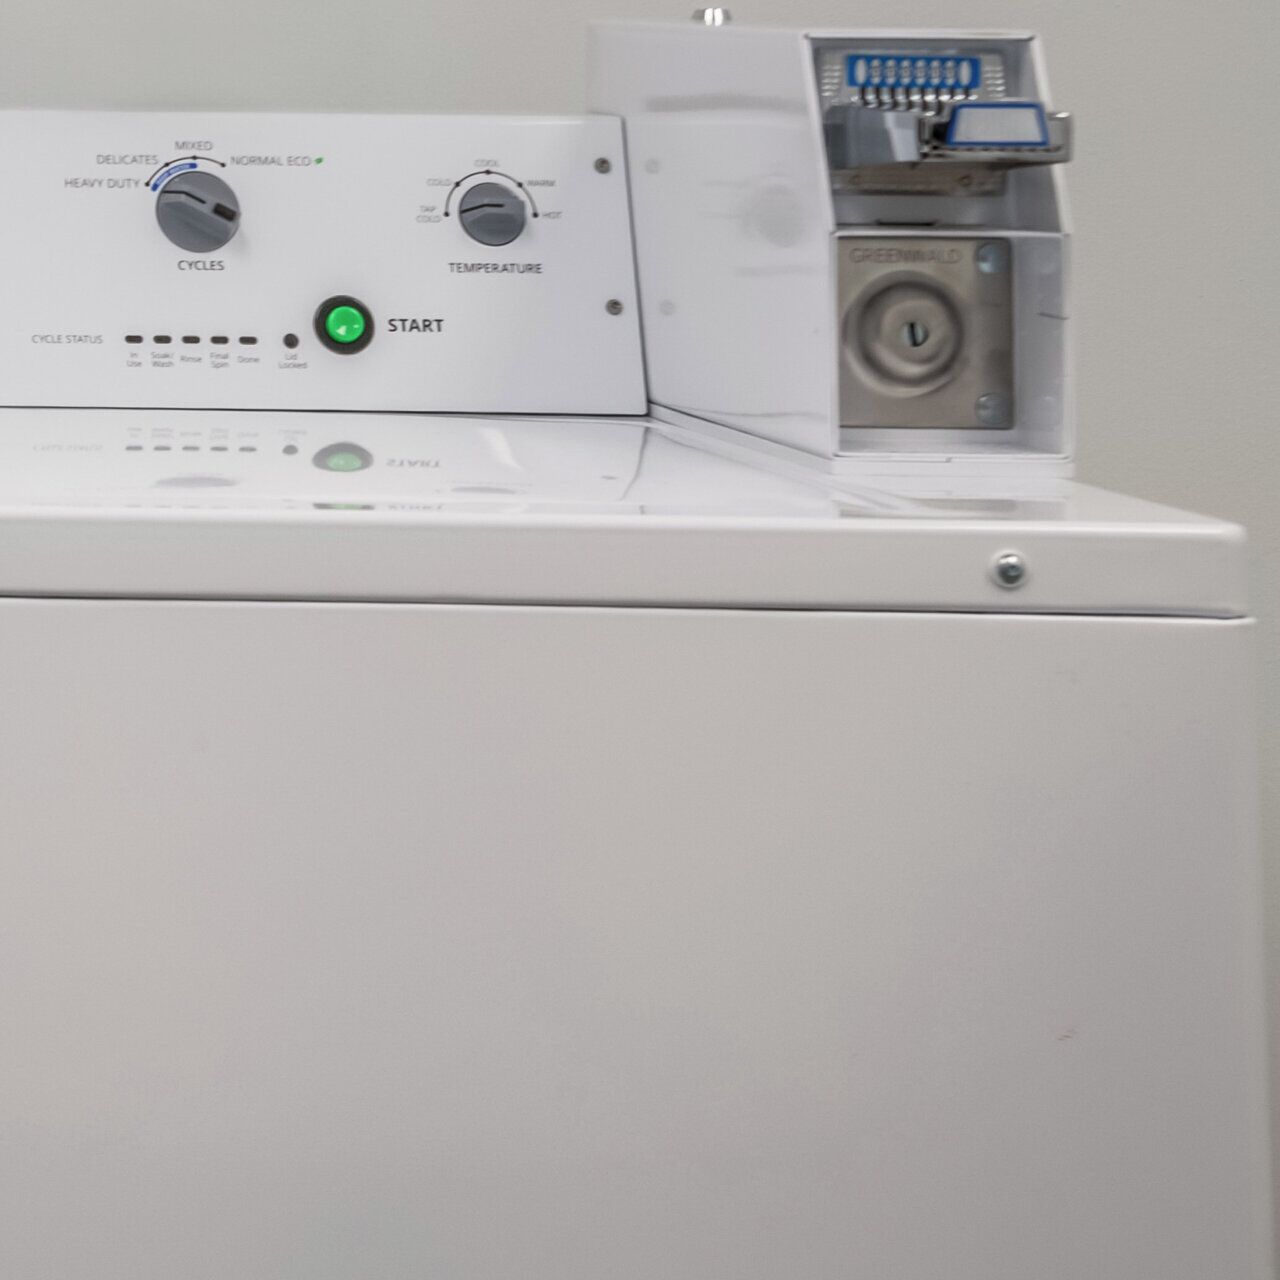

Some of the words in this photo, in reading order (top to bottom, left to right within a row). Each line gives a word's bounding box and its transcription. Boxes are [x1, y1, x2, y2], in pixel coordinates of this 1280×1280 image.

[175, 141, 213, 151] MIXED
[96, 155, 158, 165] DELICATES
[230, 156, 284, 166] NORMAL
[287, 156, 312, 166] ECO
[64, 178, 106, 188] HEAVY
[107, 178, 140, 189] DUTY
[177, 260, 225, 271] CYCLES
[448, 262, 543, 274] TEMPERATURE
[388, 318, 444, 333] START
[31, 334, 63, 345] CYCLE
[65, 334, 104, 345] STATUS
